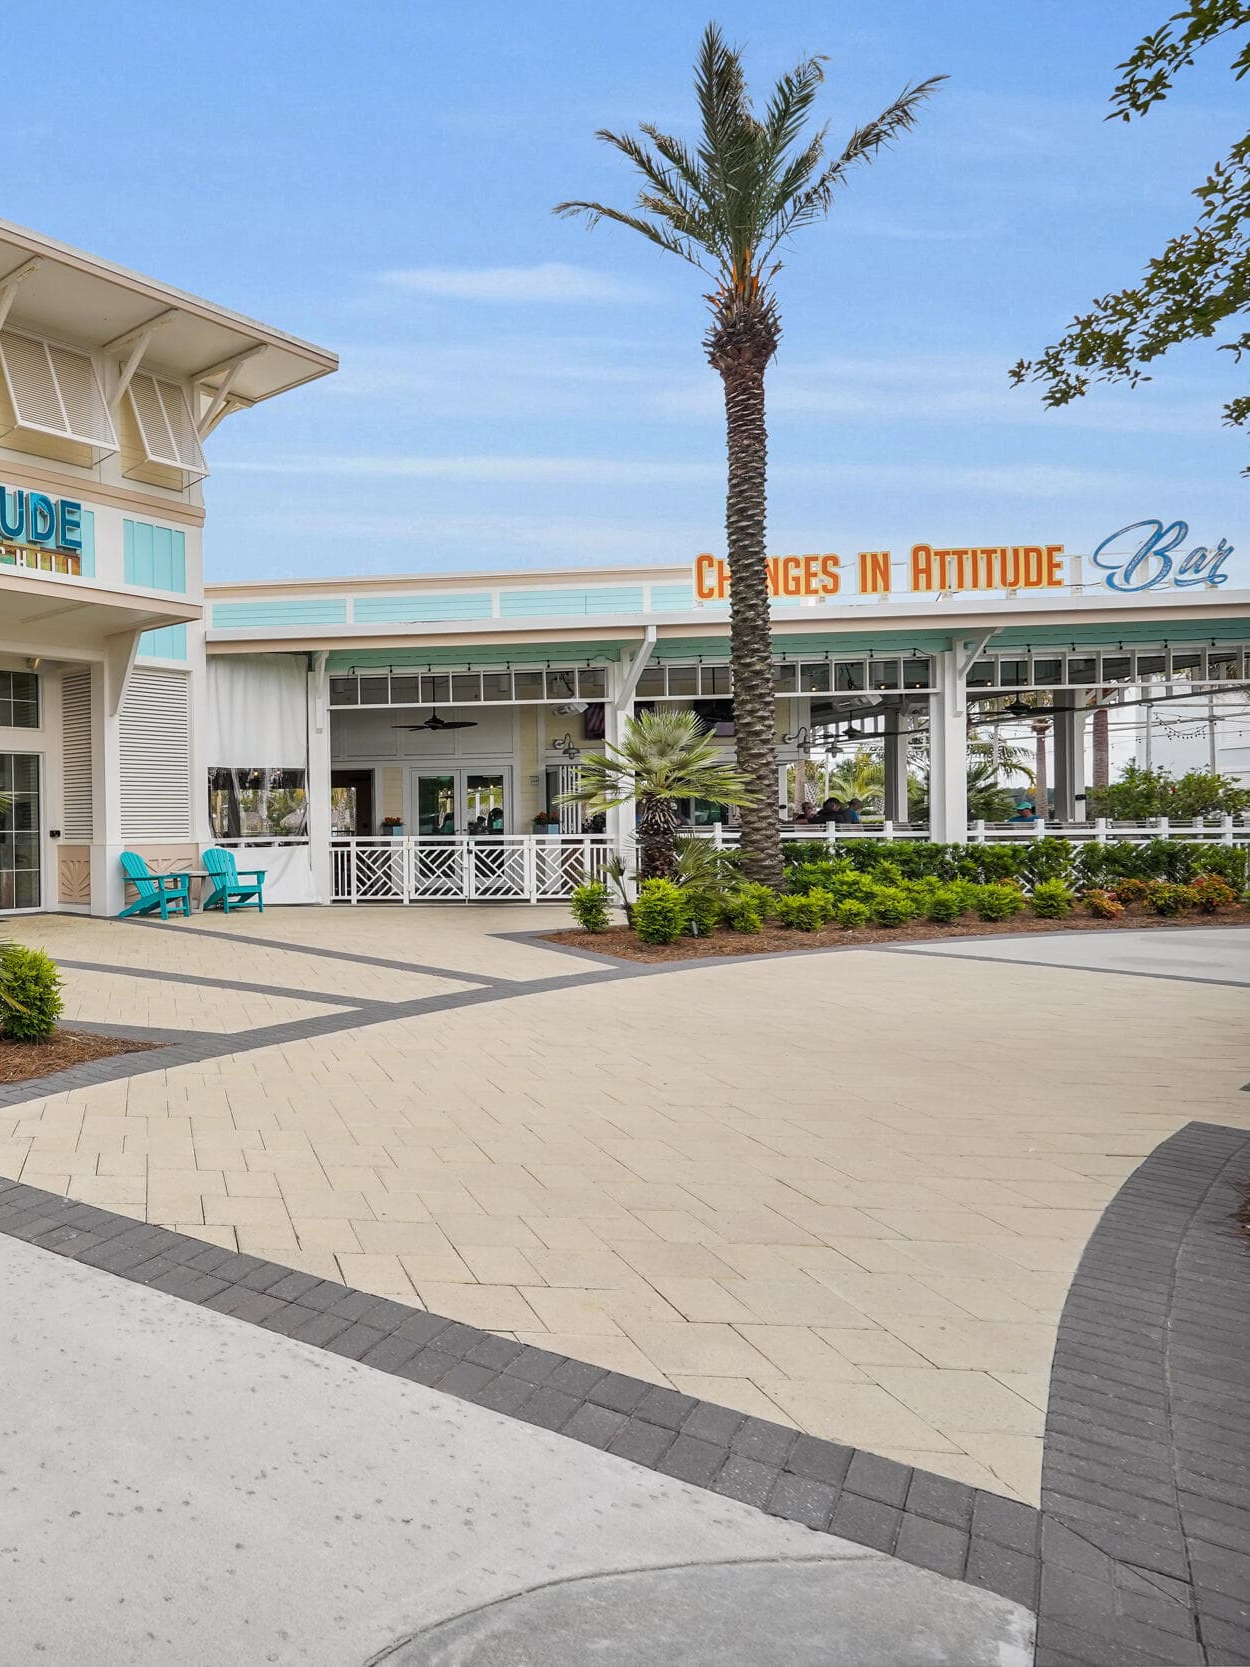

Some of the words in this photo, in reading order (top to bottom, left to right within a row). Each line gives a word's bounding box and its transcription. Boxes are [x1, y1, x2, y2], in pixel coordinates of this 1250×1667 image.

[695, 553, 840, 600] CHNGES
[858, 551, 891, 594] IN
[911, 543, 1065, 592] ATTITUDE
[1092, 518, 1235, 593] Bar
